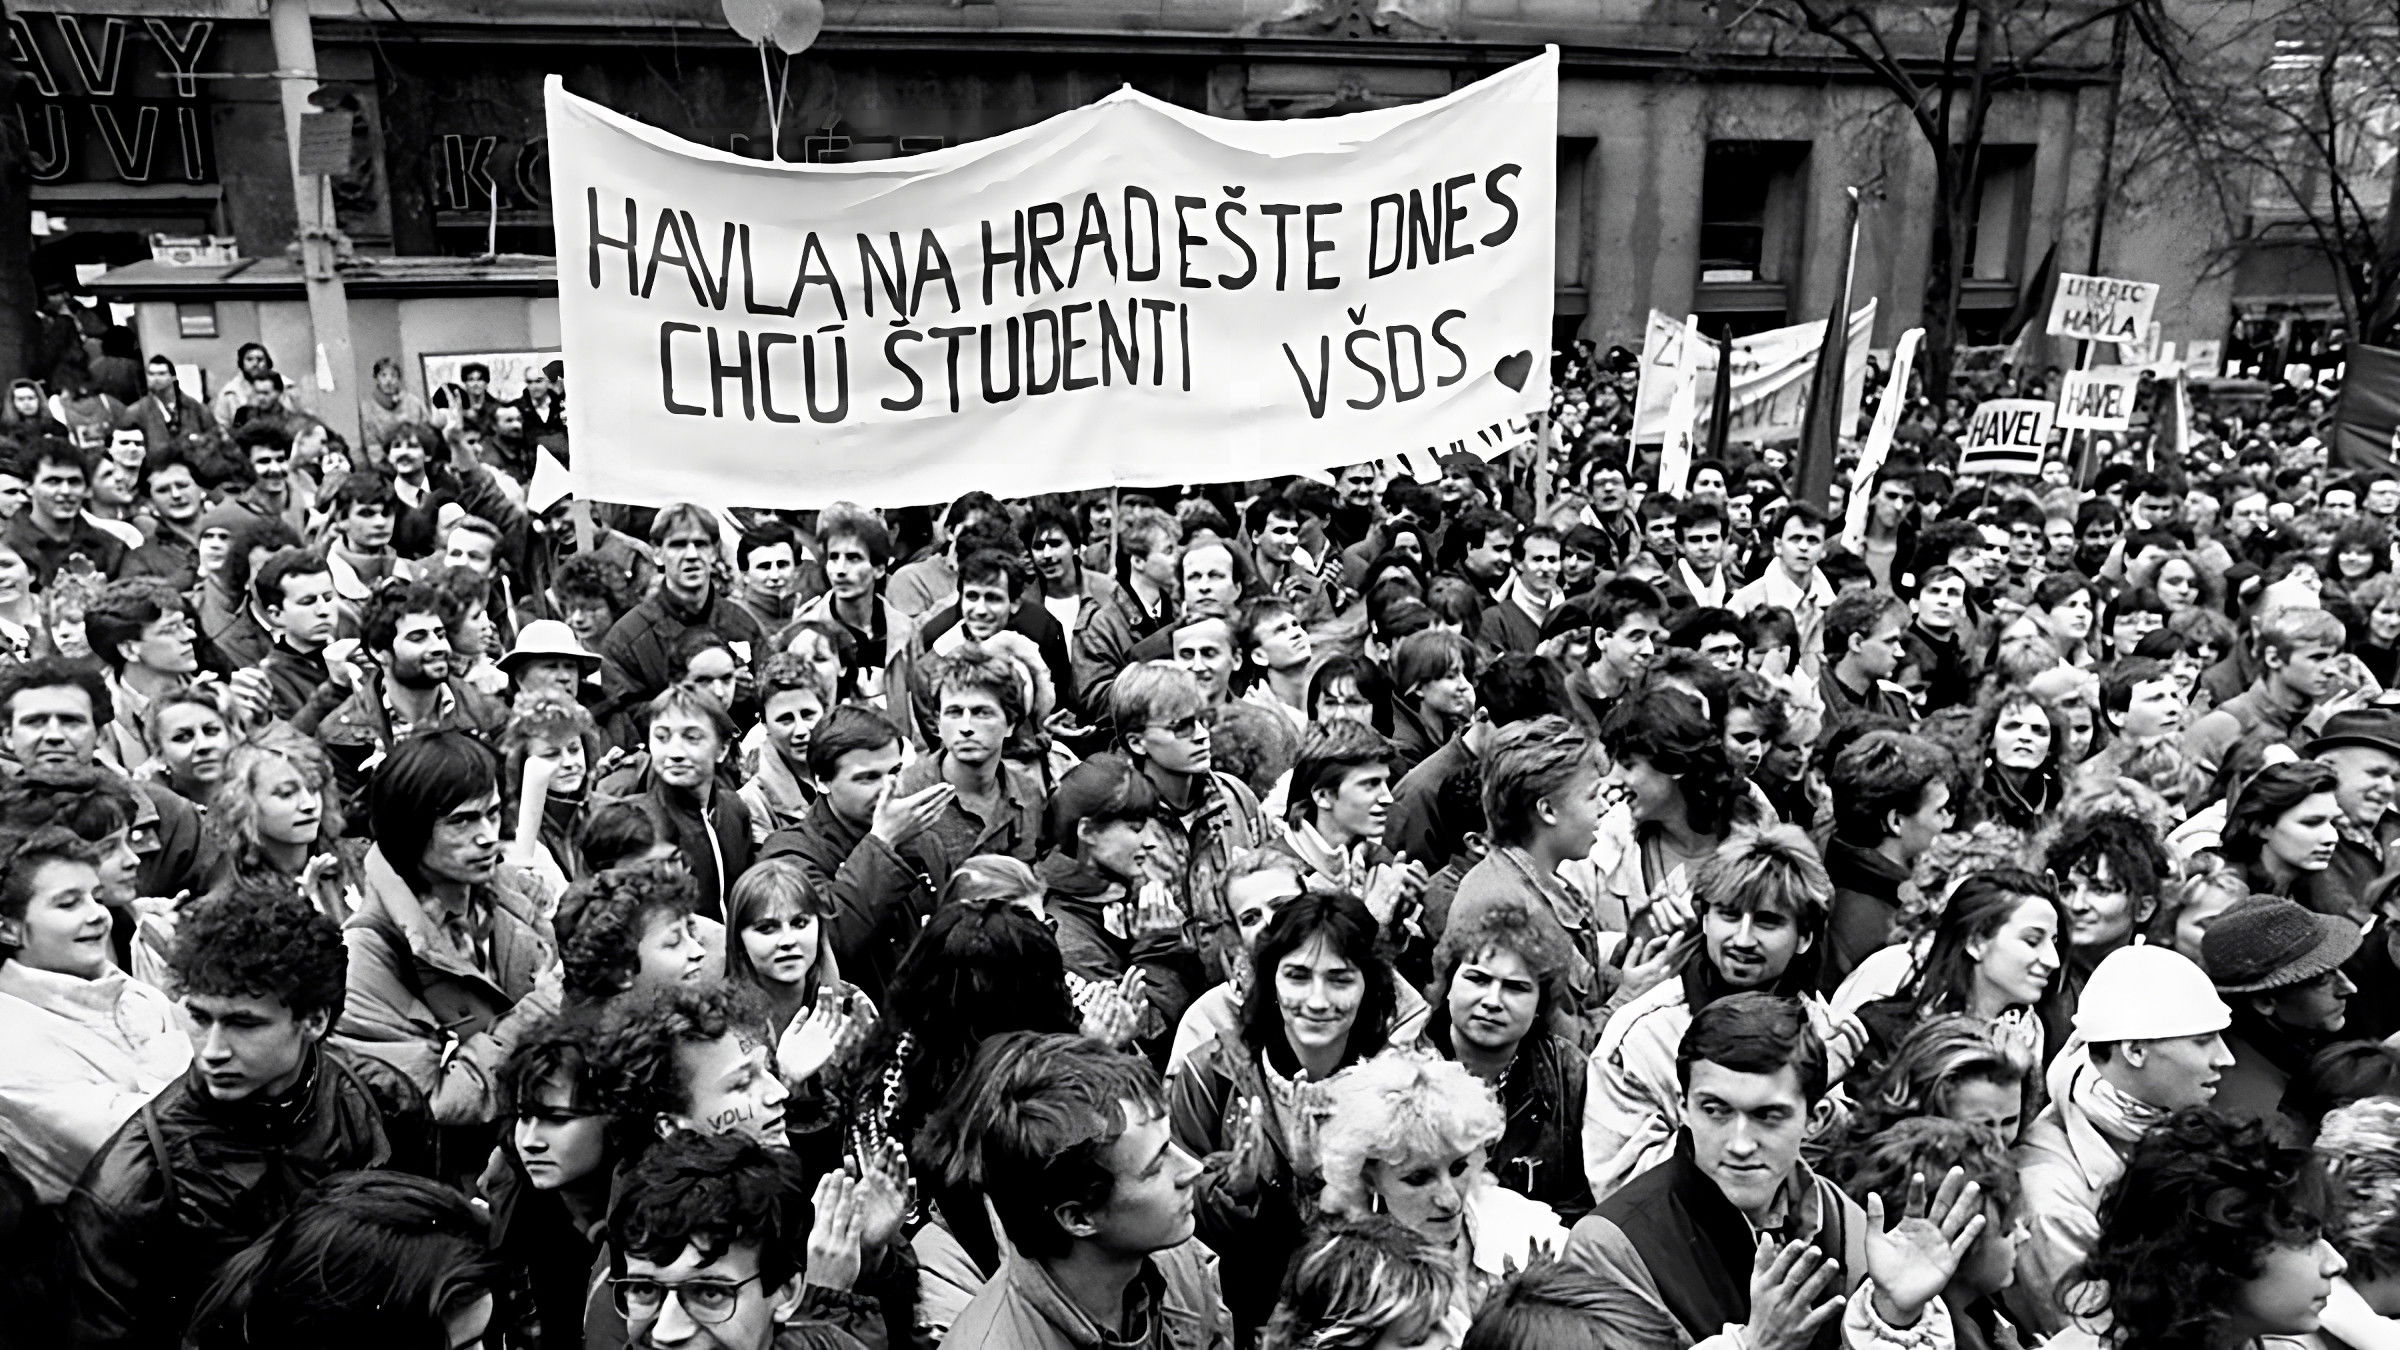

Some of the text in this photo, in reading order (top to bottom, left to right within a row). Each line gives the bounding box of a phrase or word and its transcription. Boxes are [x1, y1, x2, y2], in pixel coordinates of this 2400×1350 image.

[588, 164, 1522, 321] HAVLA NA HRAD EŠTE DNES
[661, 299, 1466, 423] CHCÚ ŠTUDENTI VŠDS
[2067, 383, 2124, 418] HAVEL
[1968, 410, 2041, 448] HAVEL
